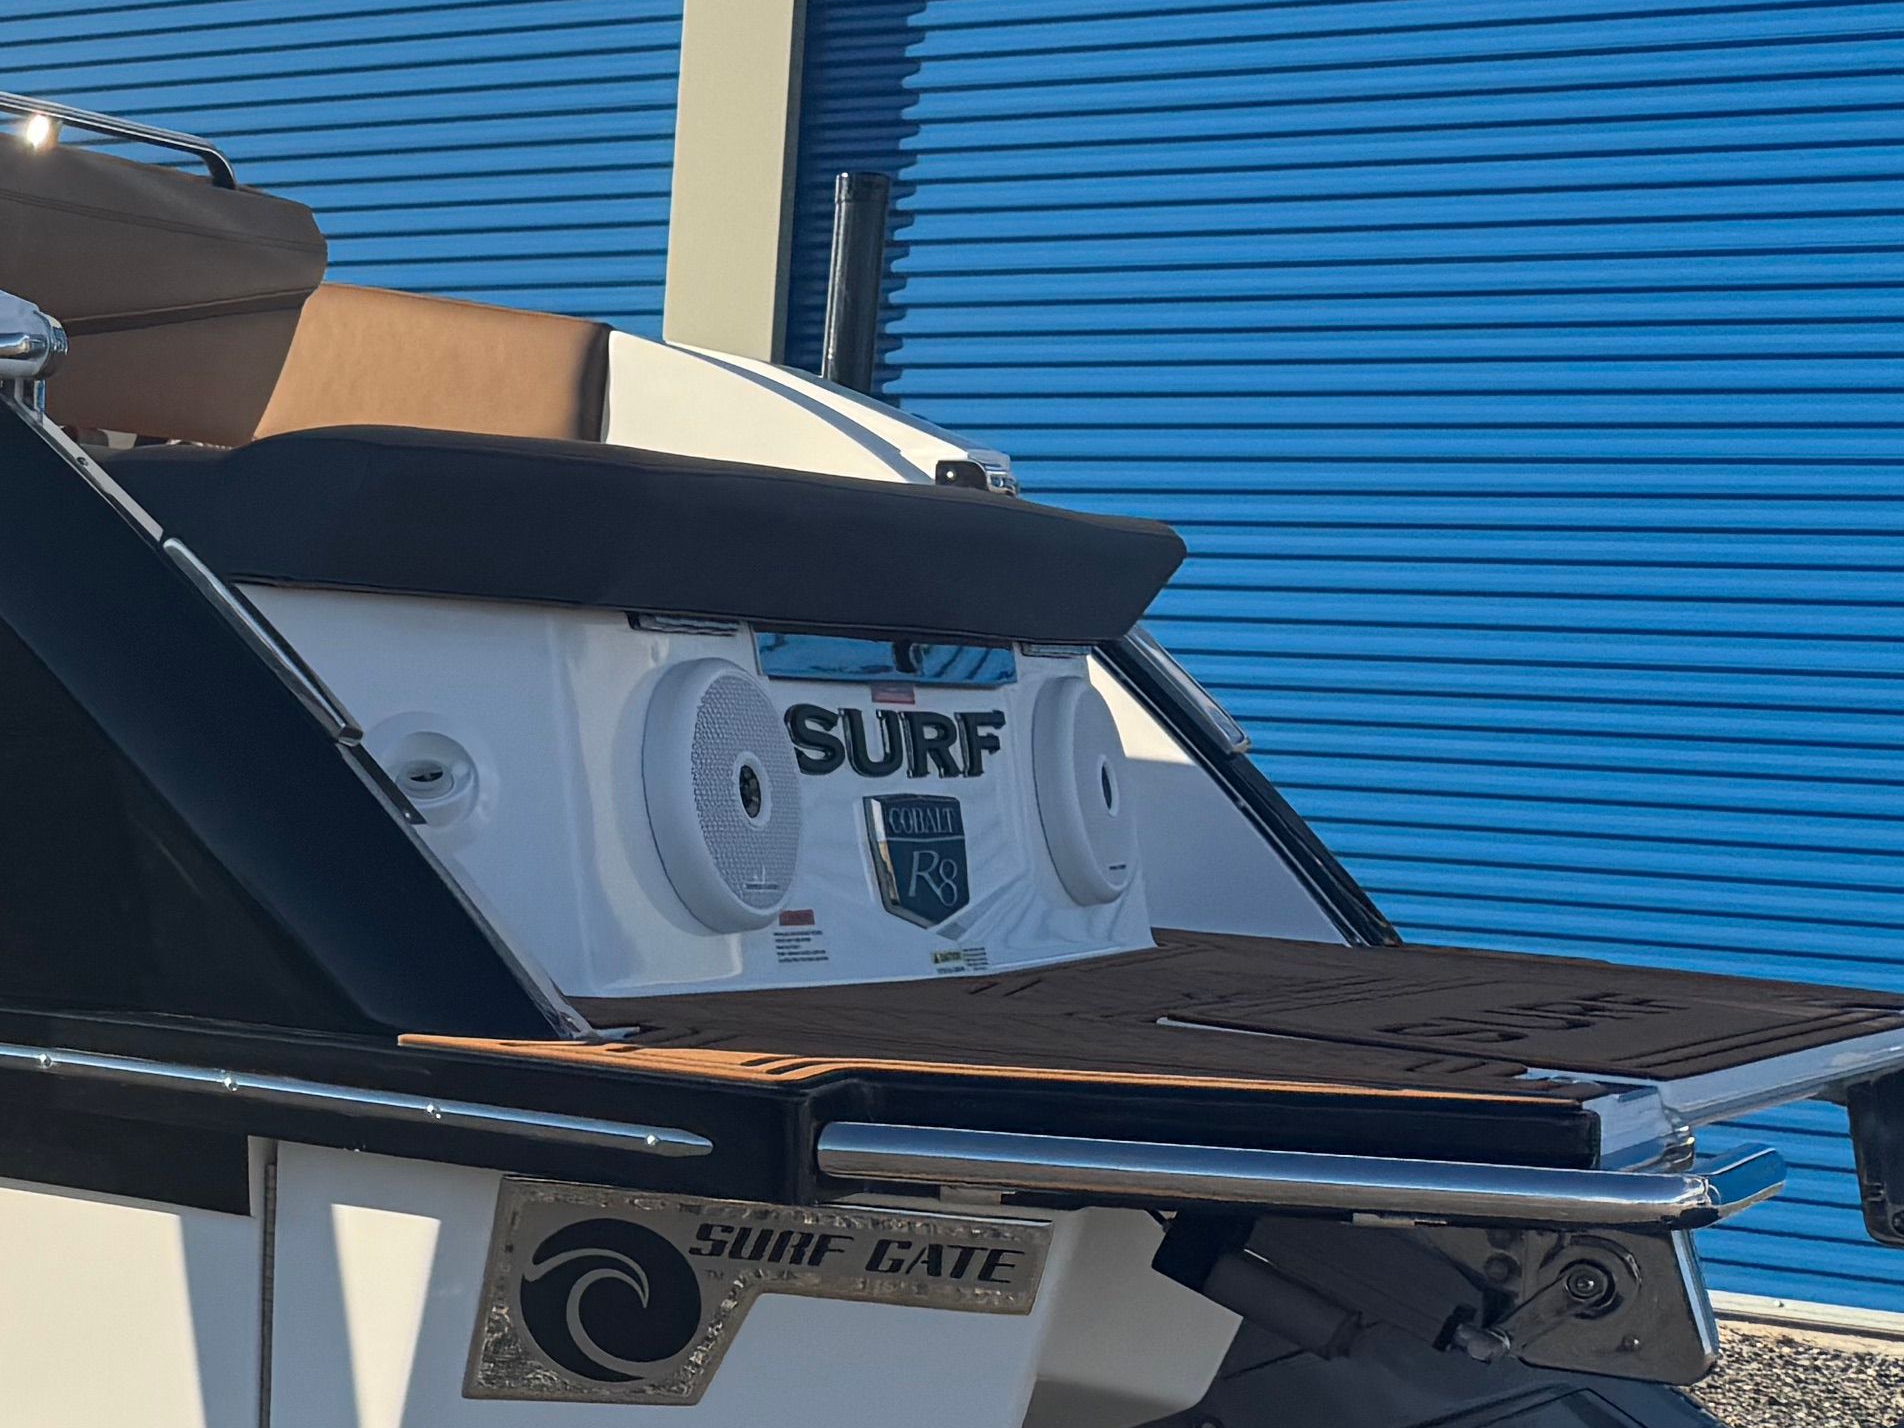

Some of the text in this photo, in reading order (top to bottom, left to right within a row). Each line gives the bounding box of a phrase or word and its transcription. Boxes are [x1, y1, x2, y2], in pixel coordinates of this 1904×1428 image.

[784, 703, 1006, 778] SURF
[888, 807, 954, 834] COBALT
[908, 849, 959, 907] R8
[688, 1223, 1026, 1284] SURF GATE
